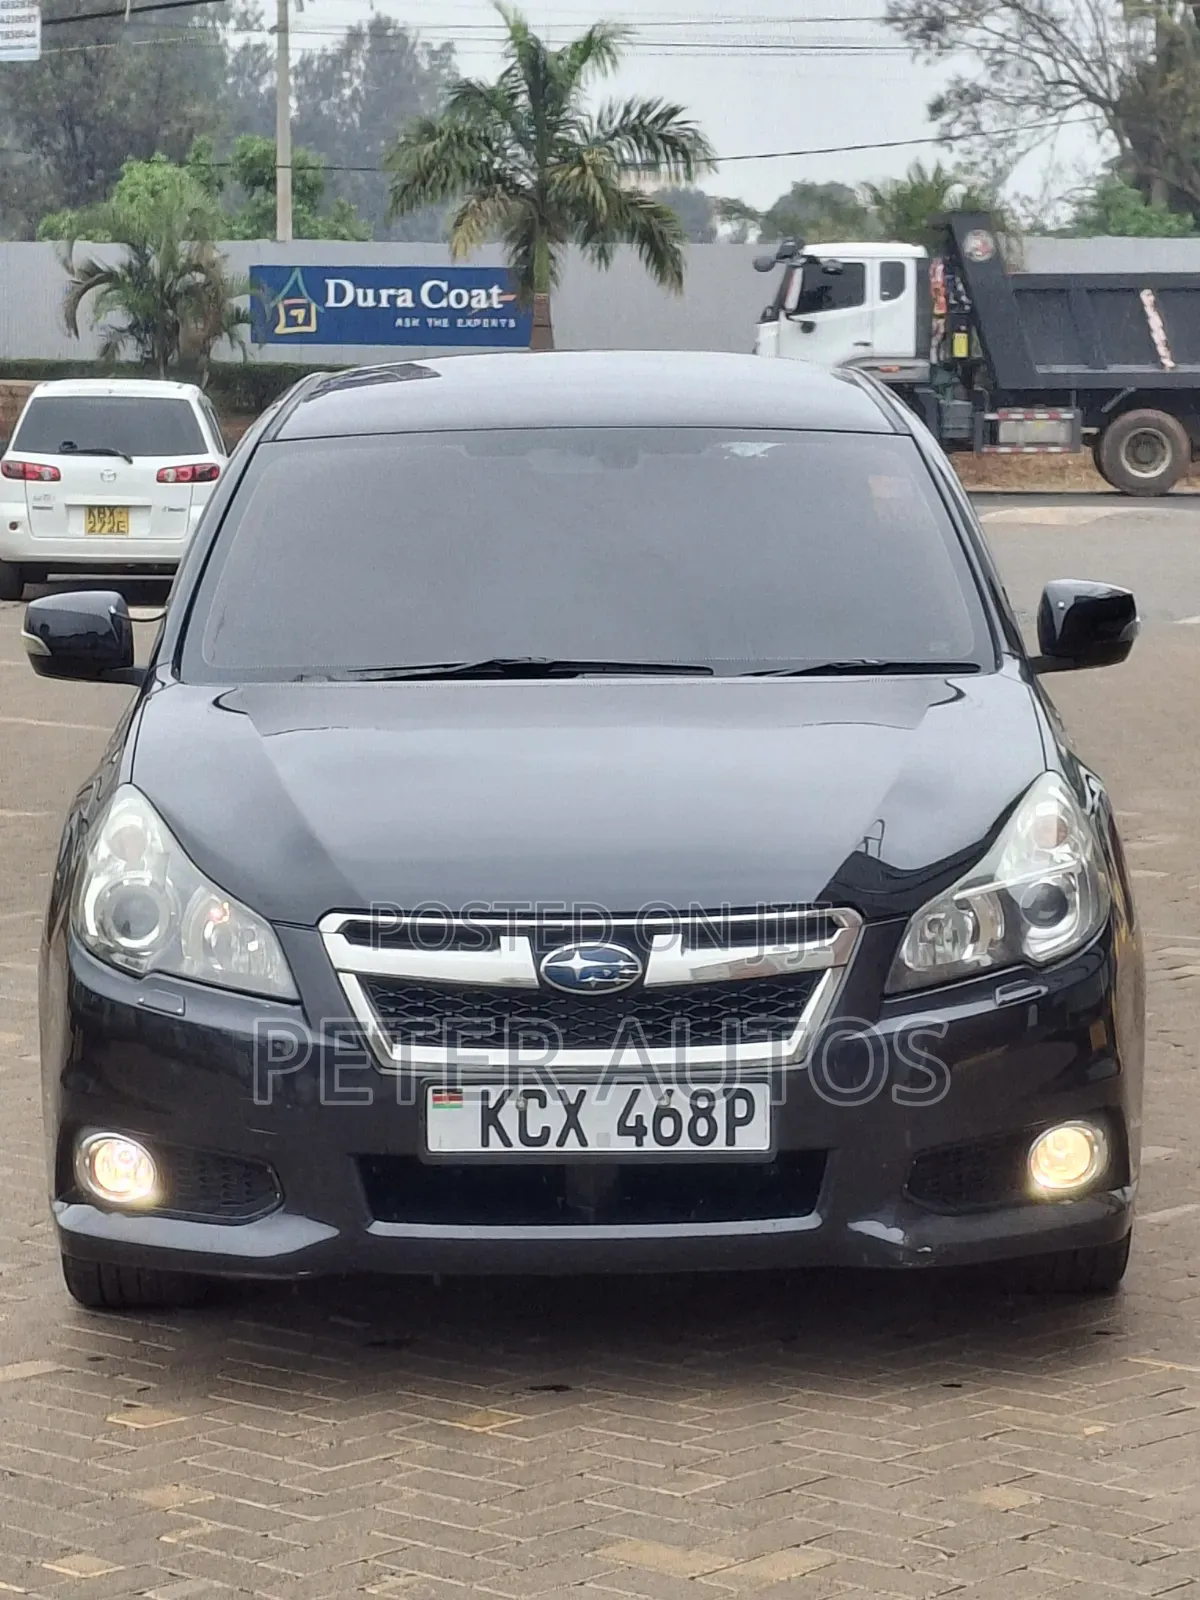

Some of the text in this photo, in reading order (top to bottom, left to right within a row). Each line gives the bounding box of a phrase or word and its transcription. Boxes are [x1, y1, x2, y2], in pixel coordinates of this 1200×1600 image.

[324, 279, 503, 309] Dura Coat
[395, 318, 420, 328] ASK
[427, 318, 449, 328] THE
[480, 1087, 756, 1148] KCX 468P
